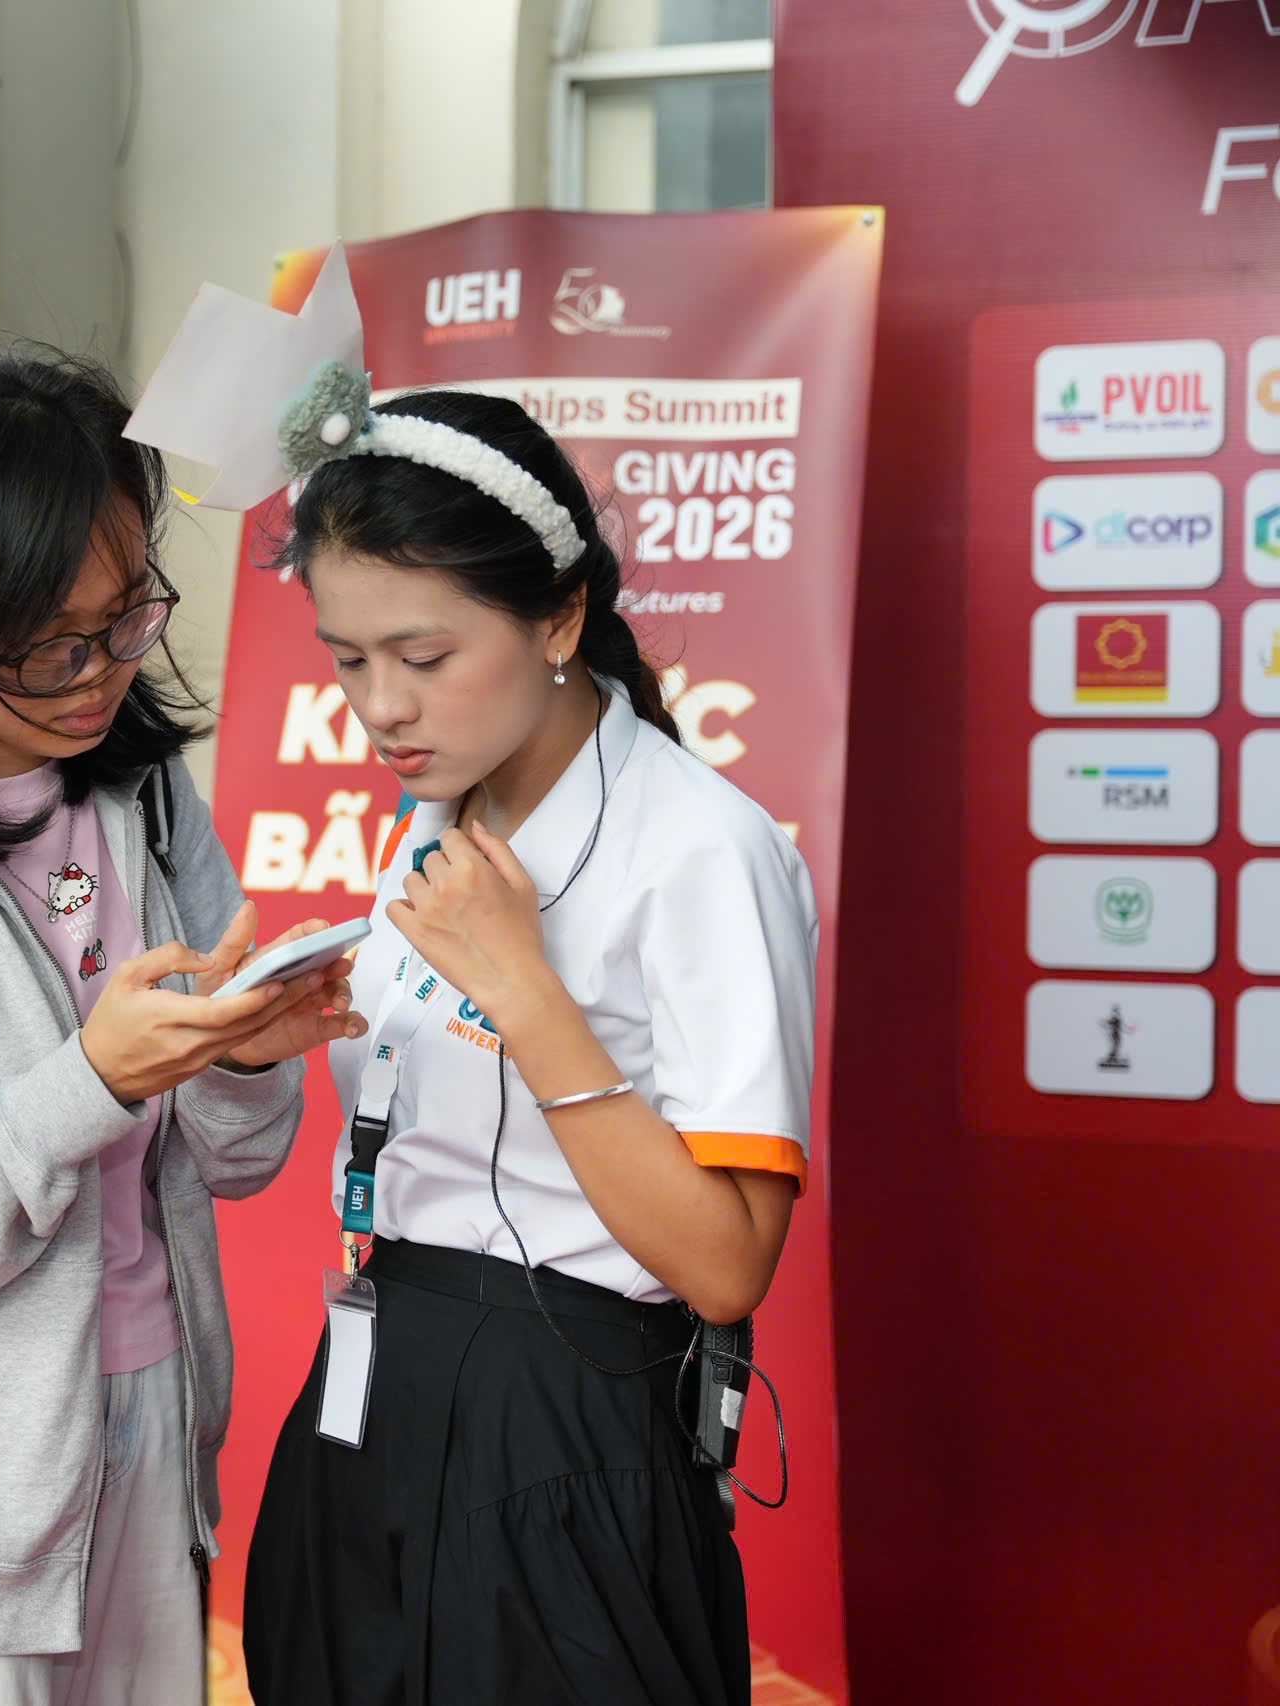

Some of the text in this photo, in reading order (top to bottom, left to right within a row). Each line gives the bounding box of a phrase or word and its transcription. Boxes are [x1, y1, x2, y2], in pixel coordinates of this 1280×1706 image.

[1201, 124, 1280, 216] F
[425, 268, 521, 327] UEH
[521, 390, 785, 427] hips Summit
[1103, 372, 1212, 416] PVOIL
[615, 449, 796, 495] GIVING
[636, 495, 794, 563] 2026
[1104, 784, 1169, 810] RSM
[415, 975, 437, 1000] UEH
[376, 1045, 391, 1060] EH
[445, 1016, 511, 1060] UNIVER
[351, 1186, 365, 1210] UEH
